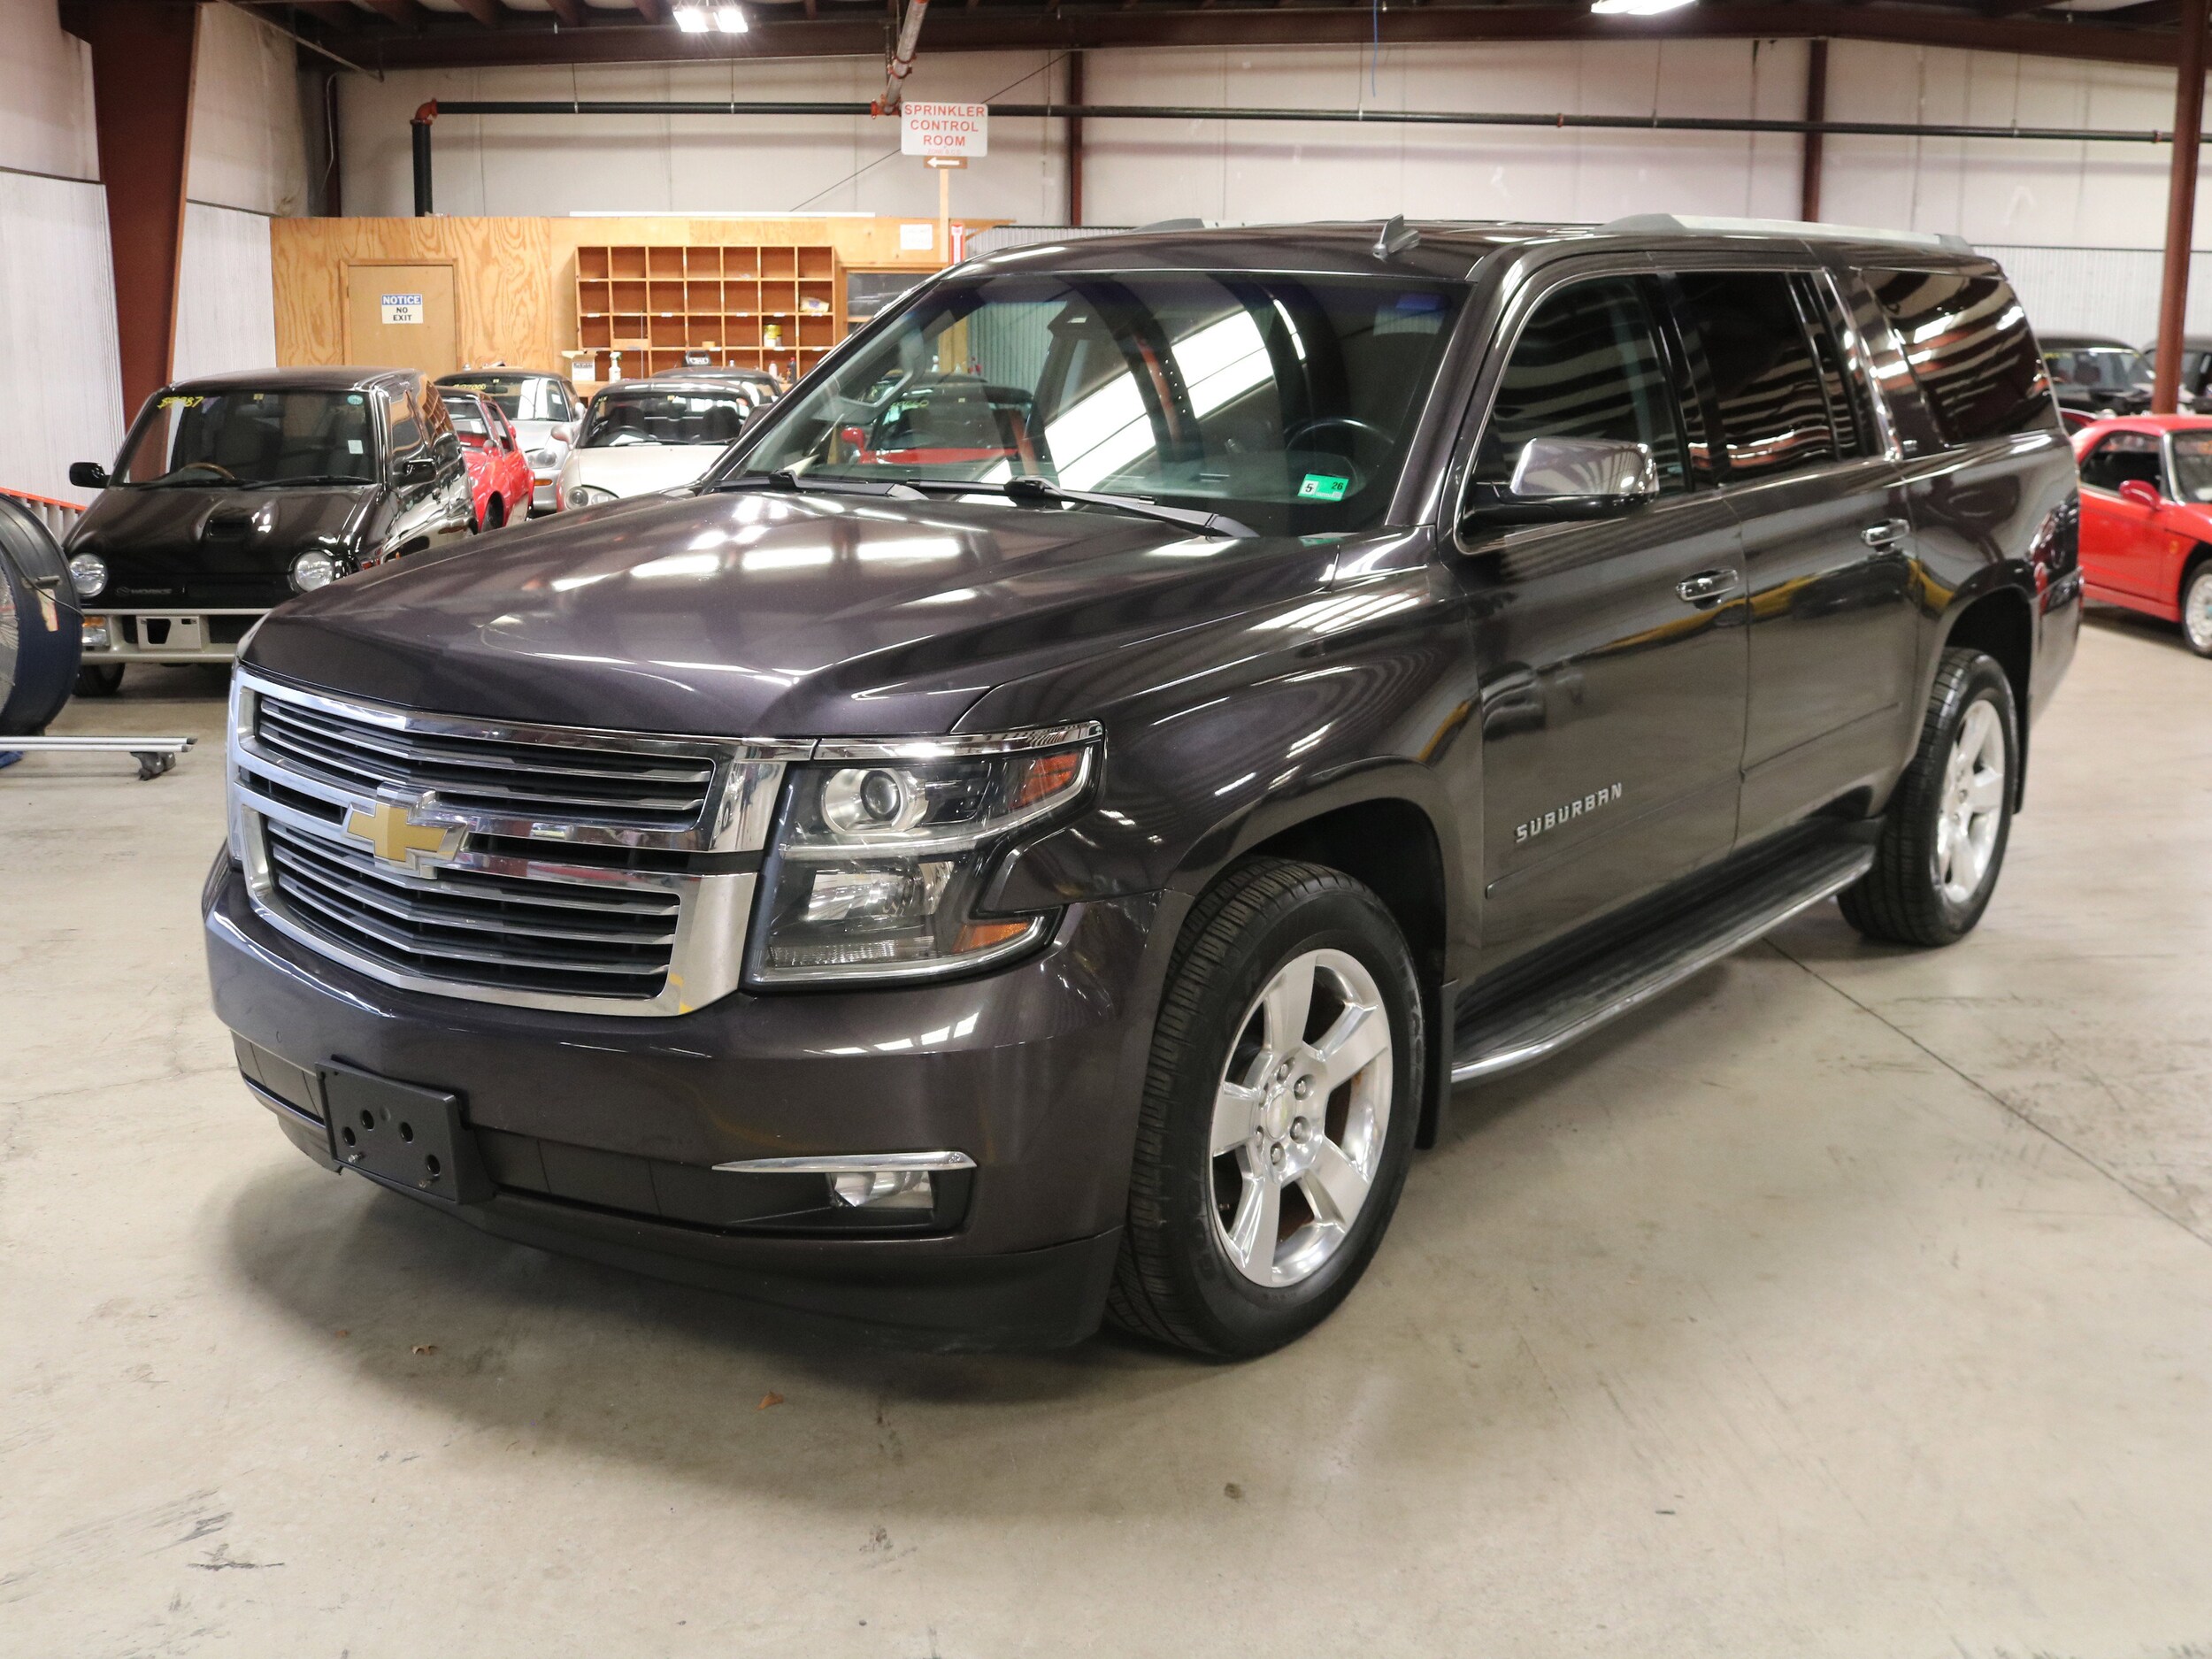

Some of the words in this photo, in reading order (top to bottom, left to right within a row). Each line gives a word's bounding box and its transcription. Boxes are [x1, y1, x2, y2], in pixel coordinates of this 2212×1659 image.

[904, 104, 985, 117] SPRINKLER
[910, 119, 979, 132] CONTROL
[923, 134, 965, 146] ROOM
[382, 296, 420, 304] NOTICE
[1305, 483, 1314, 493] 5
[1332, 481, 1344, 490] 26
[1516, 782, 1622, 843] SUBURBAN
